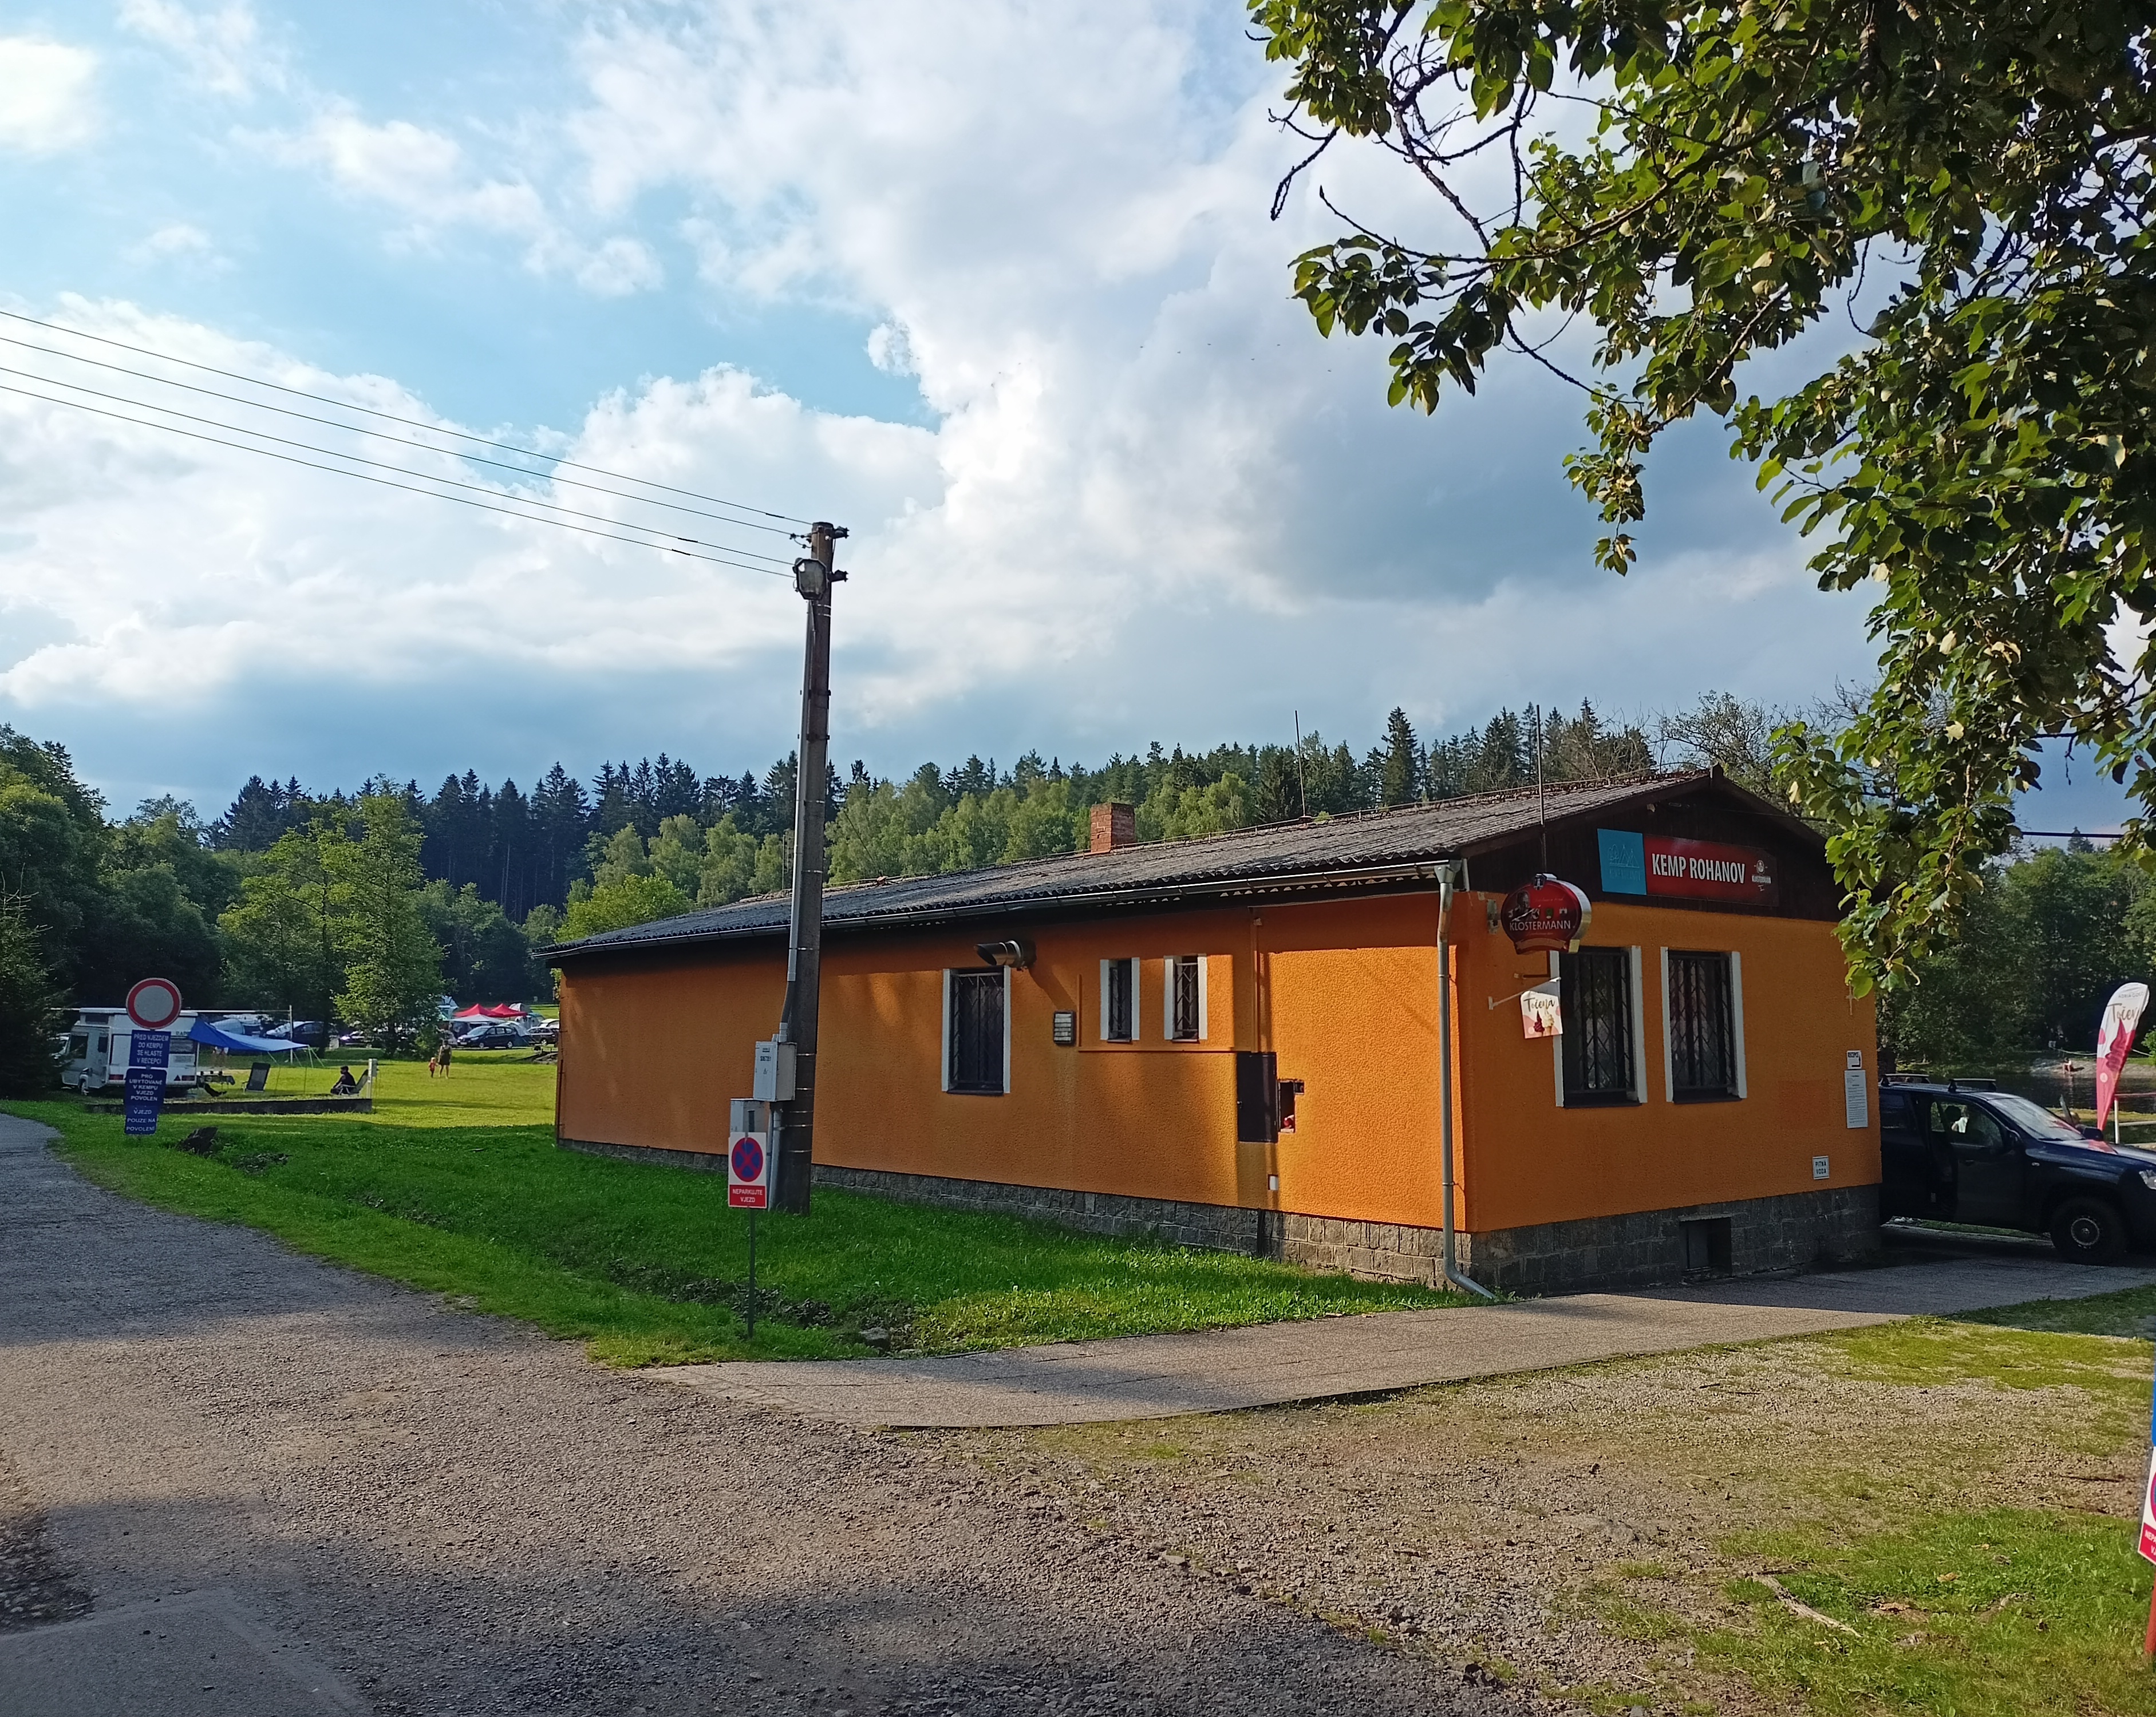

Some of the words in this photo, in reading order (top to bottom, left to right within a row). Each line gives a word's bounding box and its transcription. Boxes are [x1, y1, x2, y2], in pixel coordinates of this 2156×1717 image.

[1652, 853, 1687, 877] KEMP
[1689, 857, 1746, 884] ROHANOV
[1509, 920, 1571, 931] KLOSTERMANN
[1523, 997, 1555, 1012] Točená
